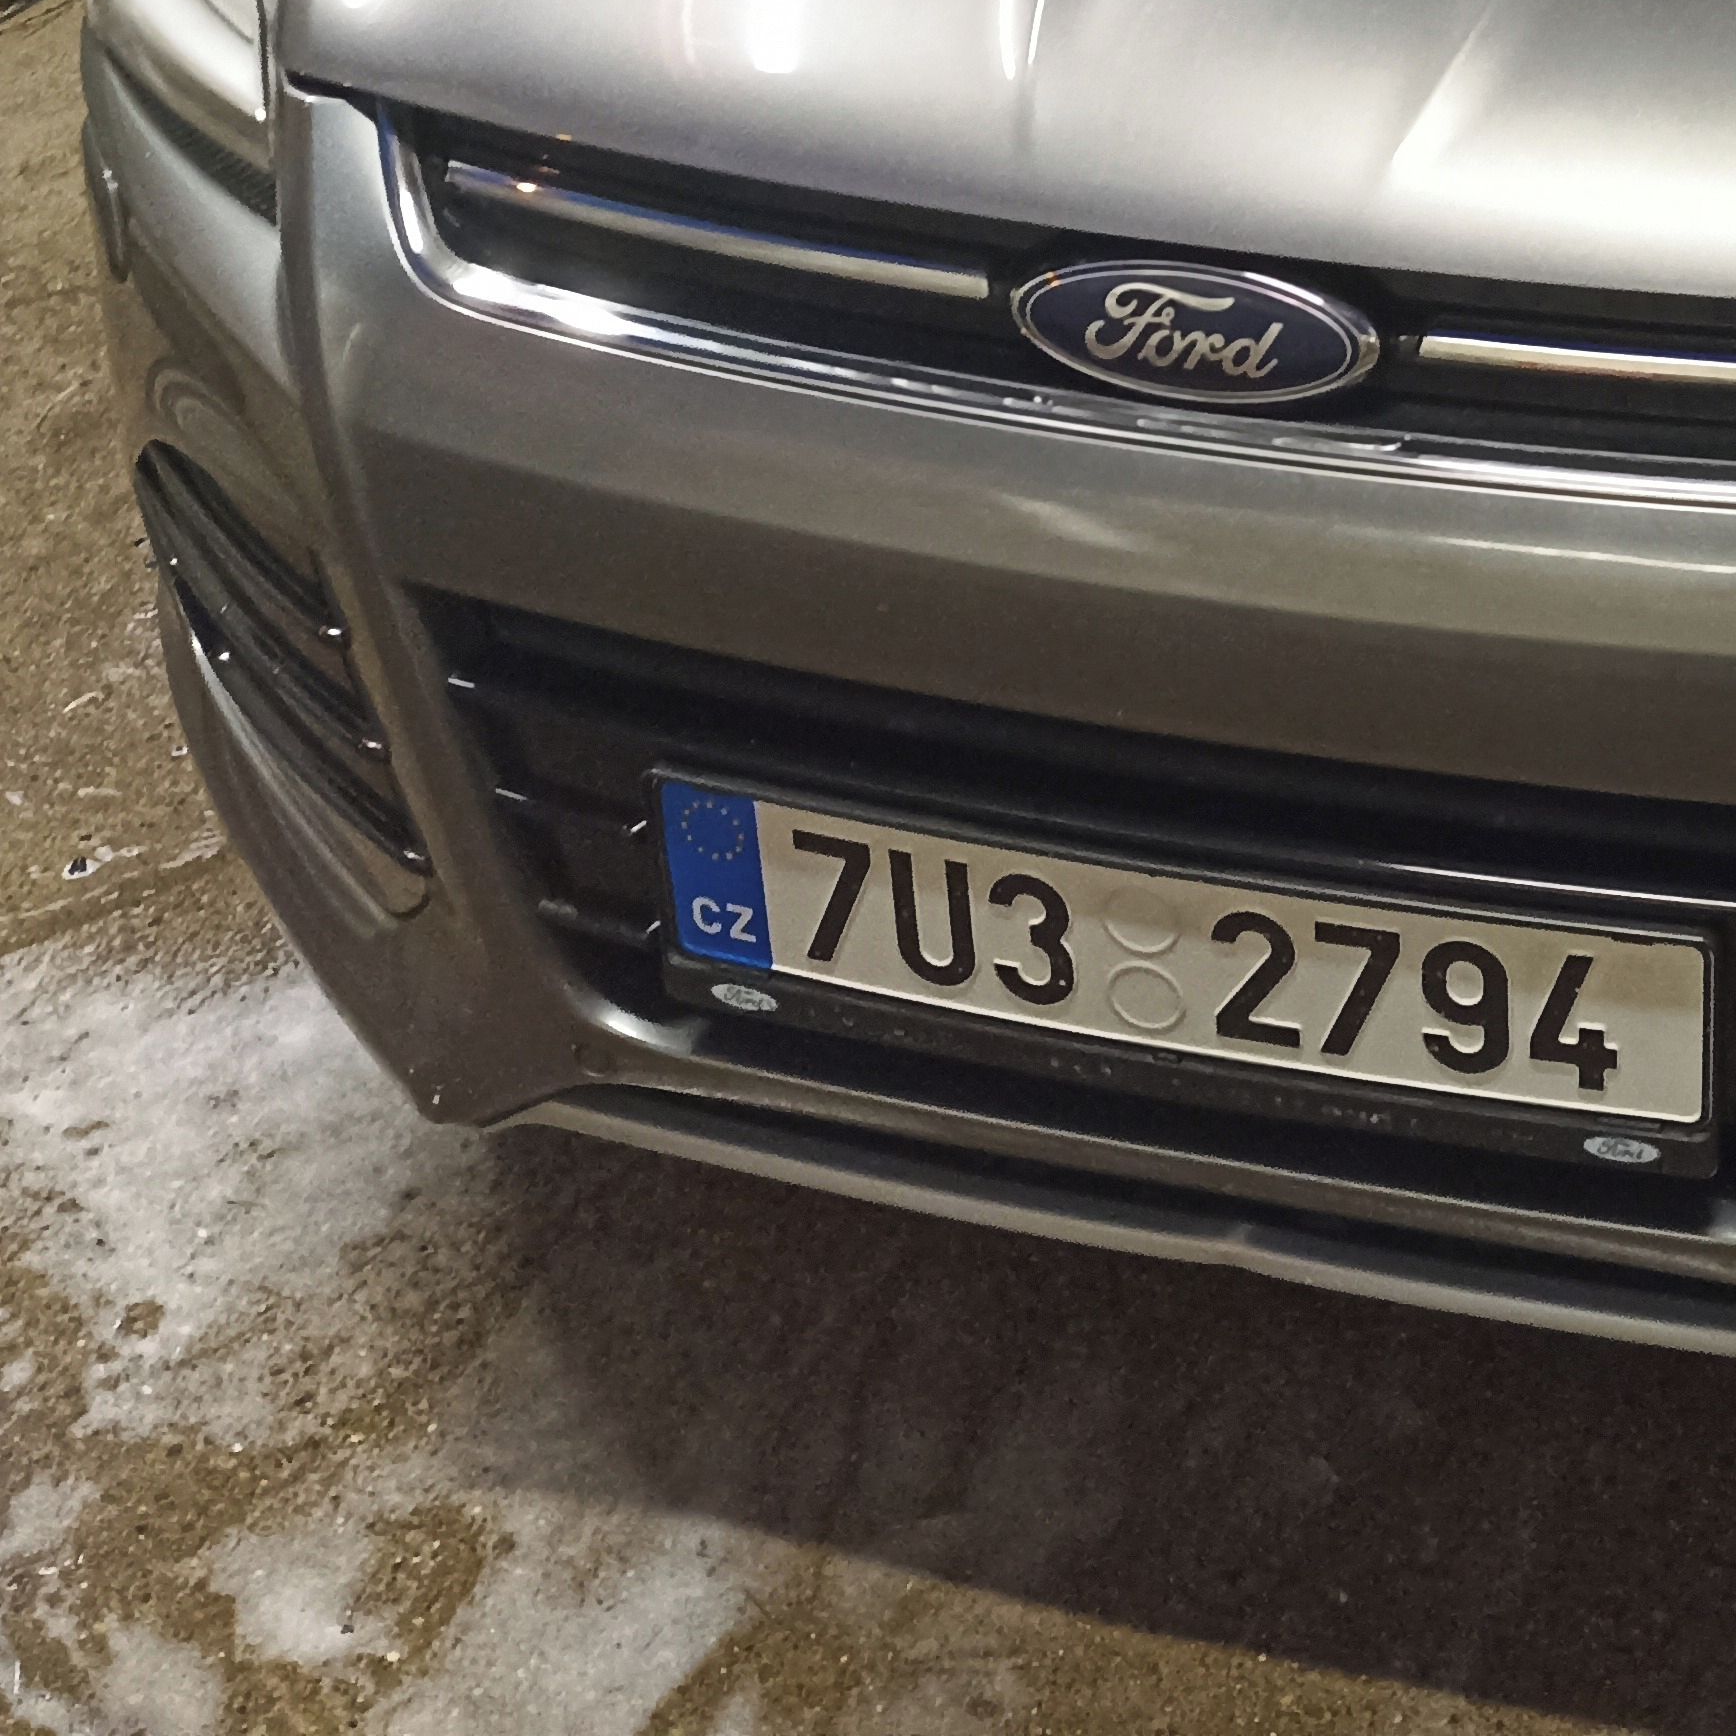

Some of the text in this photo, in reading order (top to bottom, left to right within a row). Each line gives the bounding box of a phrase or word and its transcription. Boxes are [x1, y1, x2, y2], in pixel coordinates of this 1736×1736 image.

[1084, 281, 1284, 379] Ford
[691, 895, 757, 943] CZ
[791, 828, 1618, 1092] 7U3 2794
